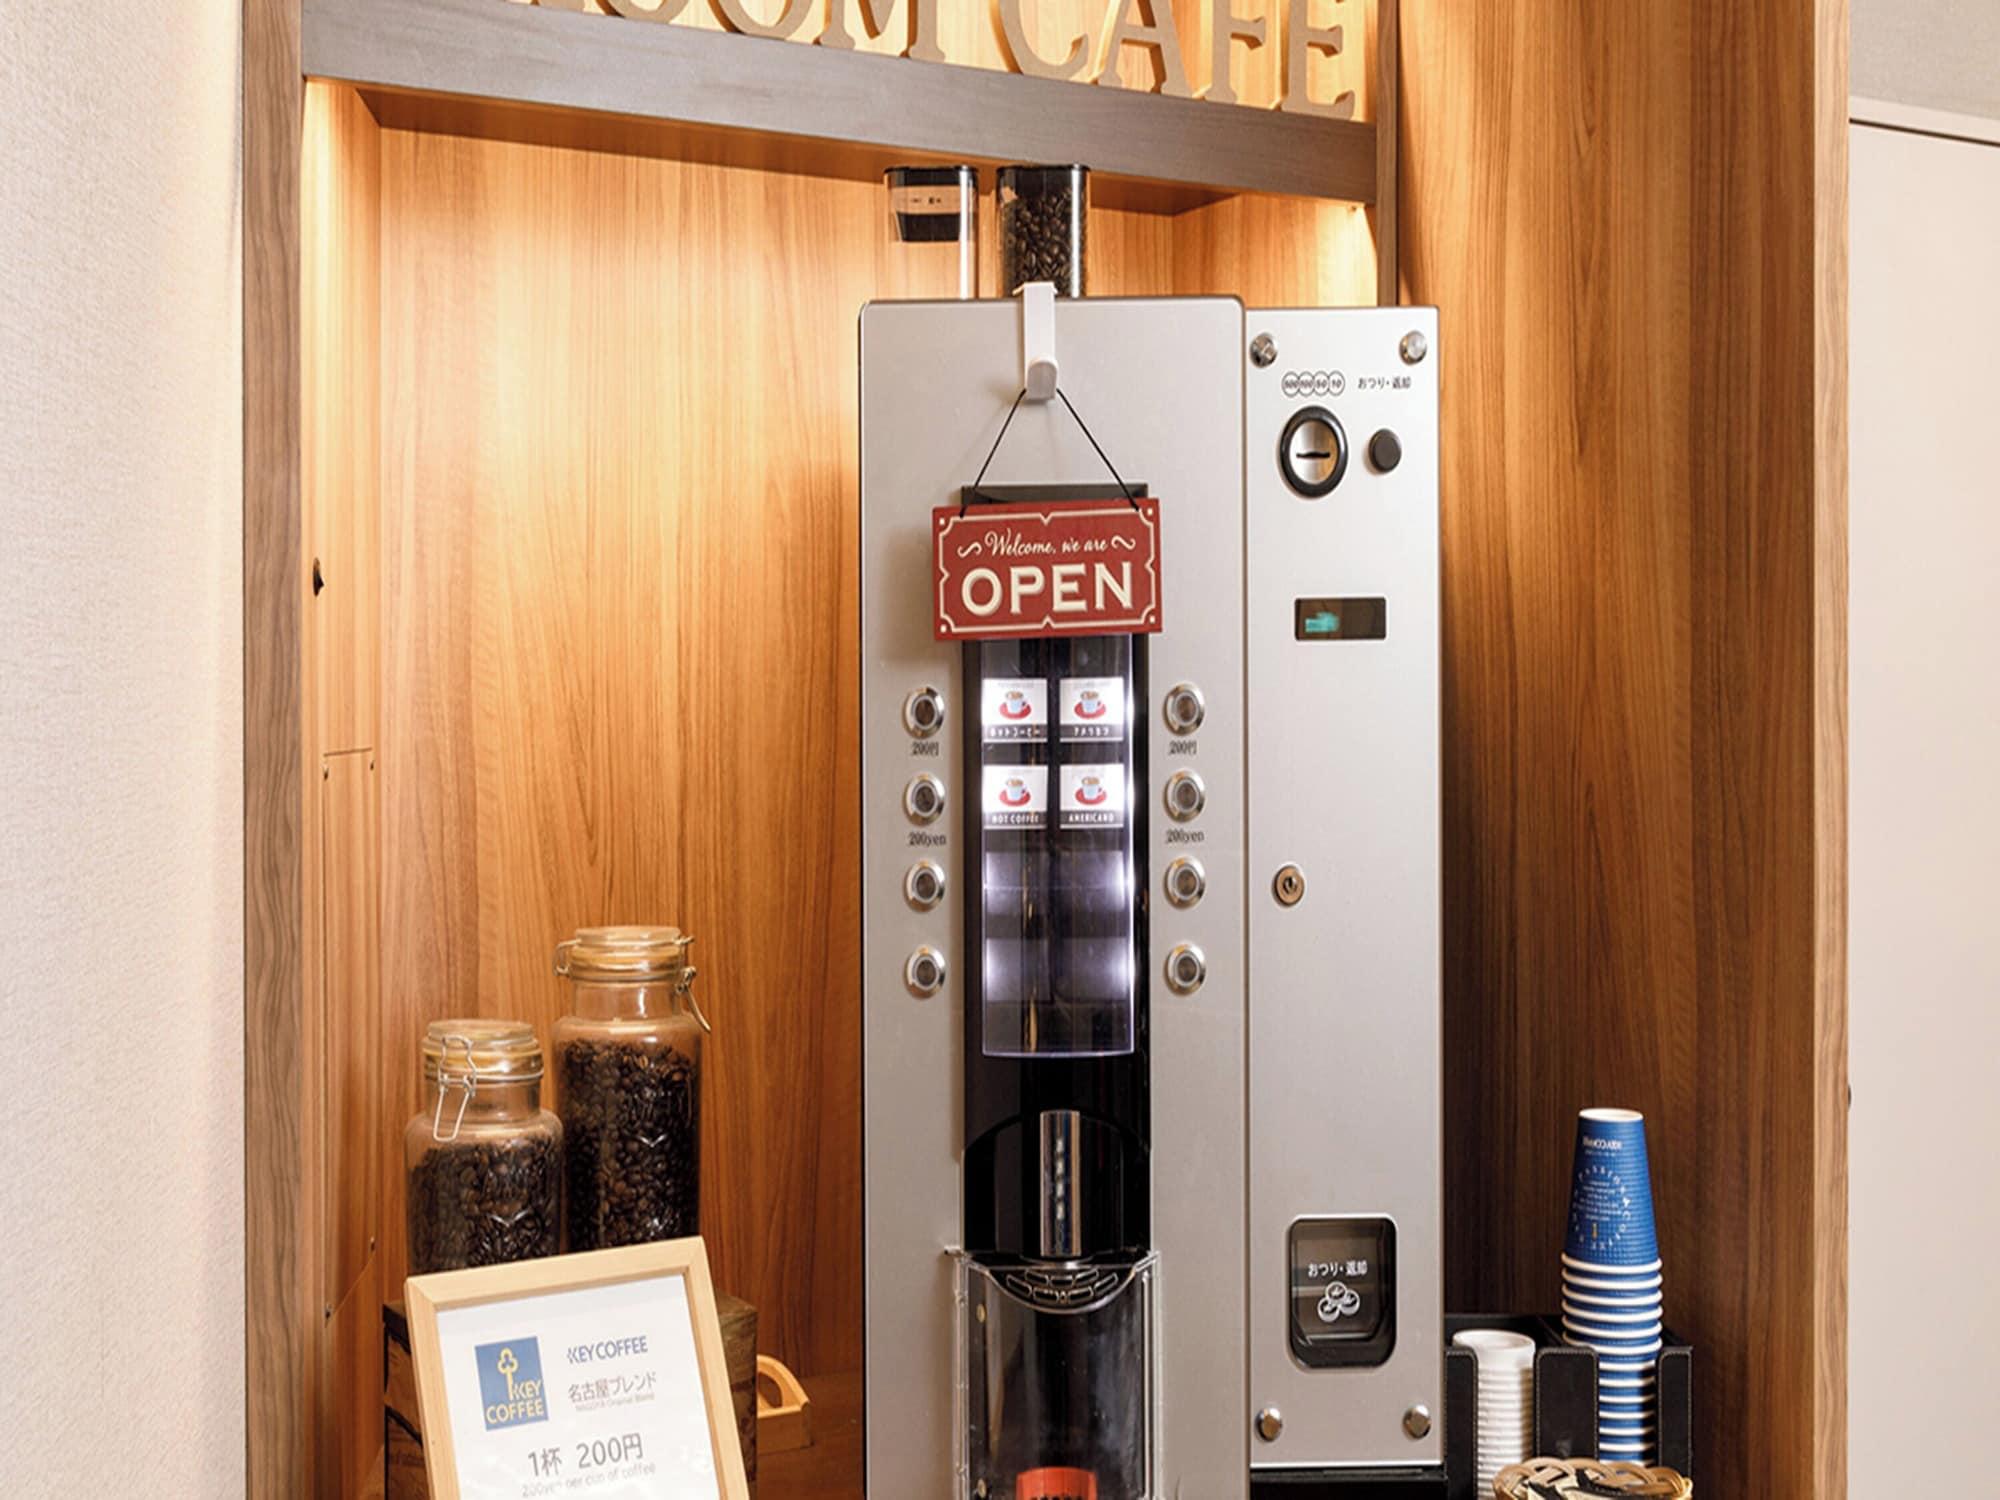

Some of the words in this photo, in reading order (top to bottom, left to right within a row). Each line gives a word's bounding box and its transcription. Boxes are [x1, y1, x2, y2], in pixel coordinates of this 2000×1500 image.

[1062, 537, 1081, 552] we
[1084, 539, 1109, 552] are
[961, 561, 1135, 617] OPEN
[512, 1379, 541, 1401] KEY
[568, 1371, 657, 1403] 名古屋ブレンド
[486, 1399, 545, 1425] COFFEE
[527, 1446, 562, 1477] 1杯
[575, 1432, 643, 1469] 200円
